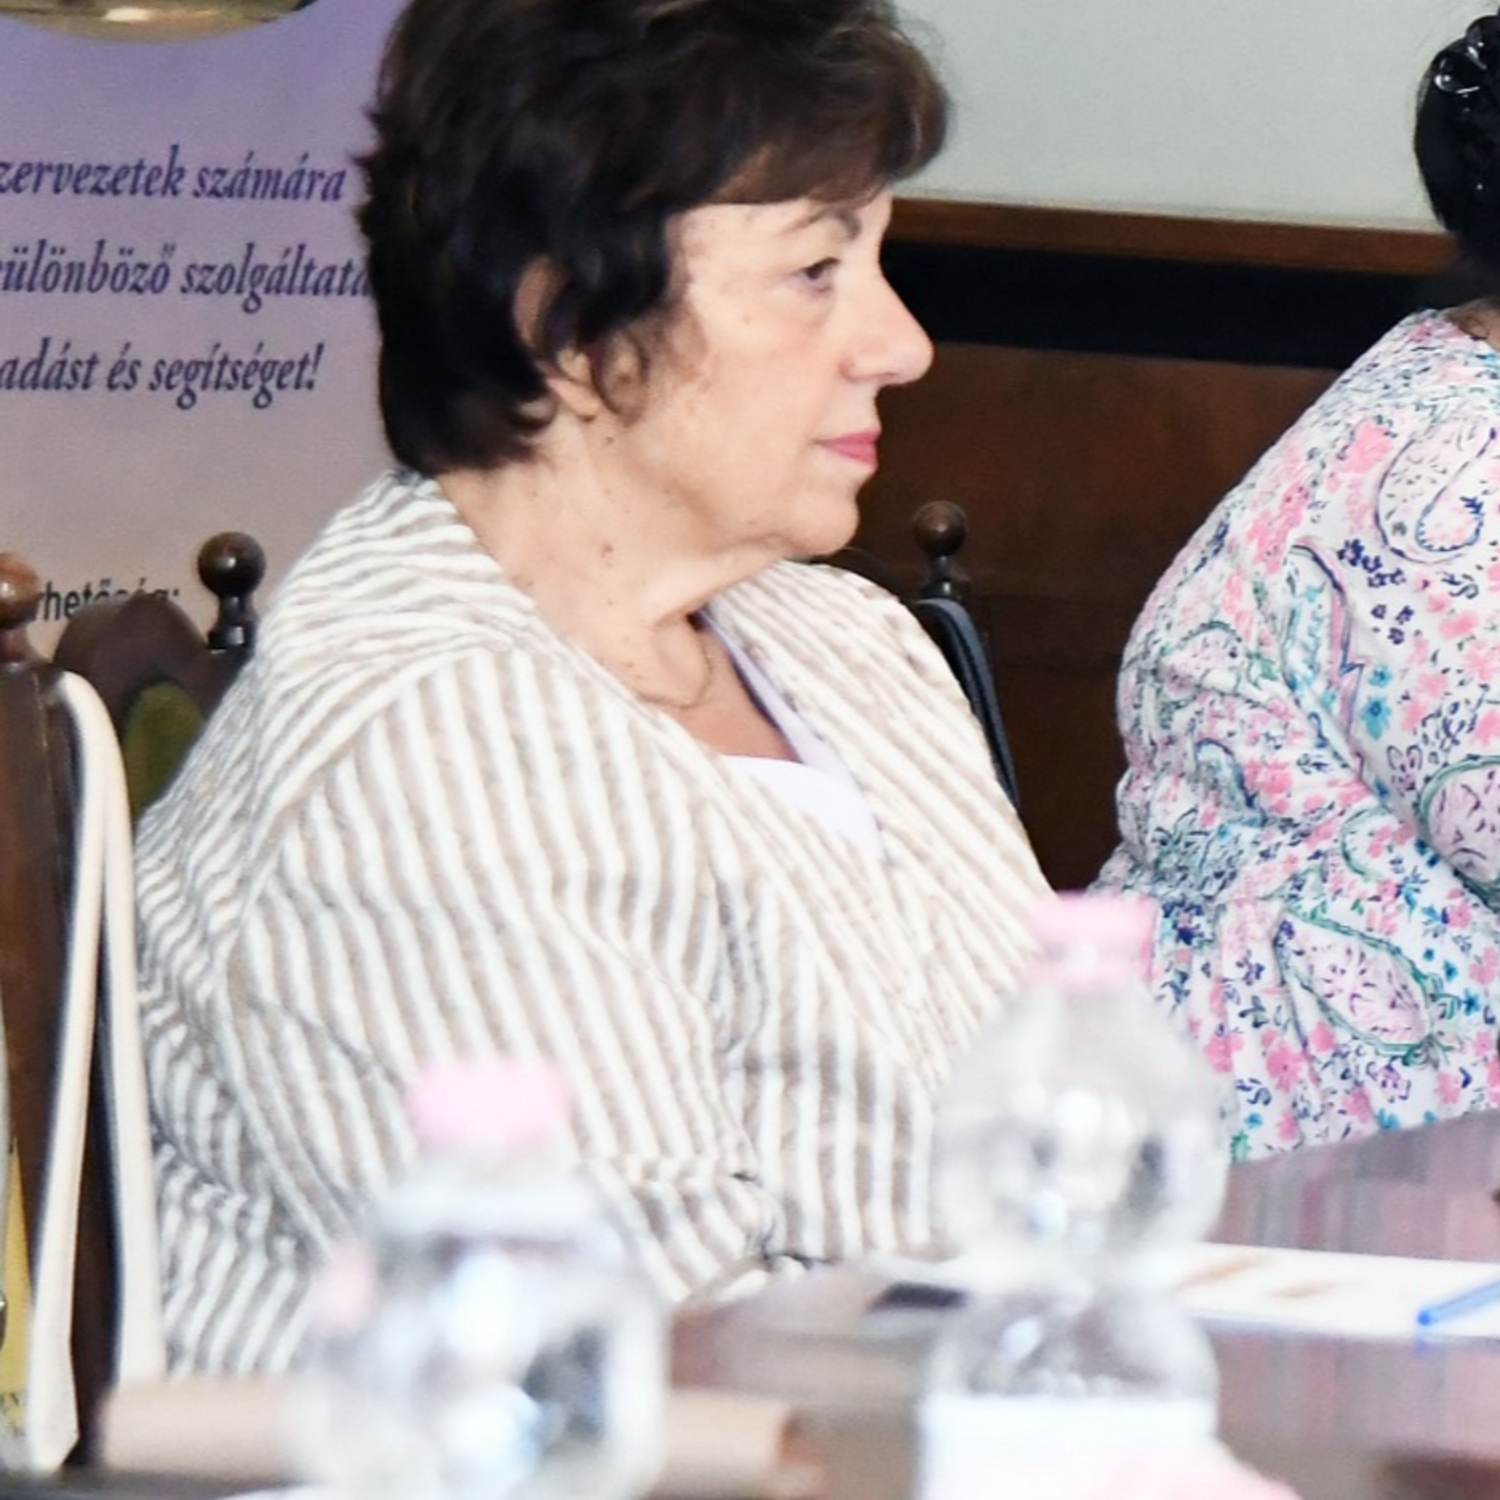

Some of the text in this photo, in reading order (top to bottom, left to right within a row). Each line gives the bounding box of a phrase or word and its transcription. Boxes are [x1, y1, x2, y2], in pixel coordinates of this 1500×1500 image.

[192, 151, 347, 200] számára
[0, 239, 176, 295] ülönböző
[106, 342, 142, 392] és
[148, 342, 325, 410] segítséget!
